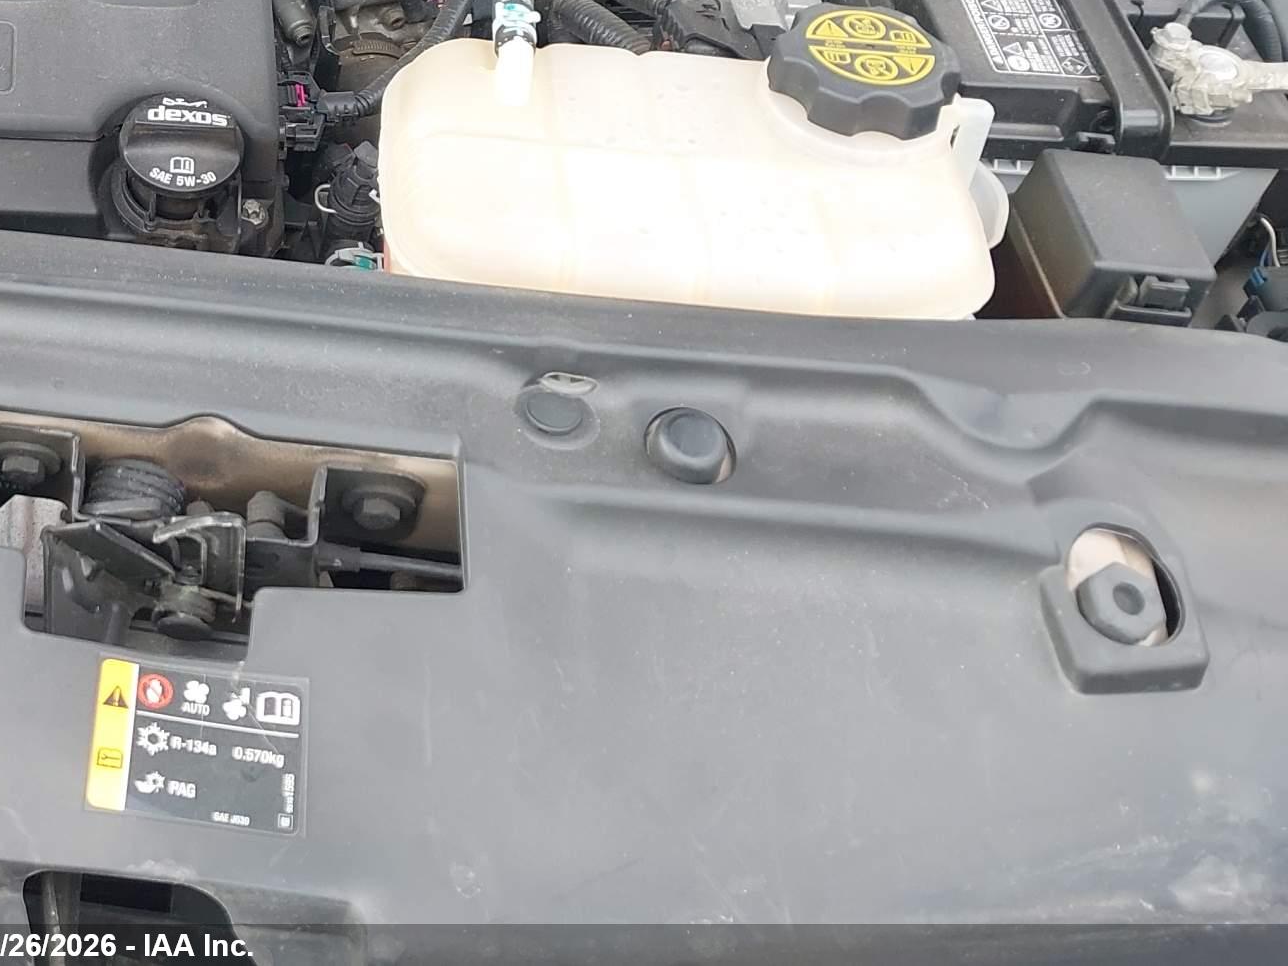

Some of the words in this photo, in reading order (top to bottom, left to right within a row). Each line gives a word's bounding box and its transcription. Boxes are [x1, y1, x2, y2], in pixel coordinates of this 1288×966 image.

[148, 105, 228, 127] dexos
[149, 167, 173, 185] SAE
[176, 171, 217, 187] 5W-30
[182, 702, 210, 716] AUTO
[170, 735, 217, 757] R-134a
[232, 744, 285, 768] 0.570kg
[168, 779, 197, 799] PAG
[212, 811, 229, 823] SAE
